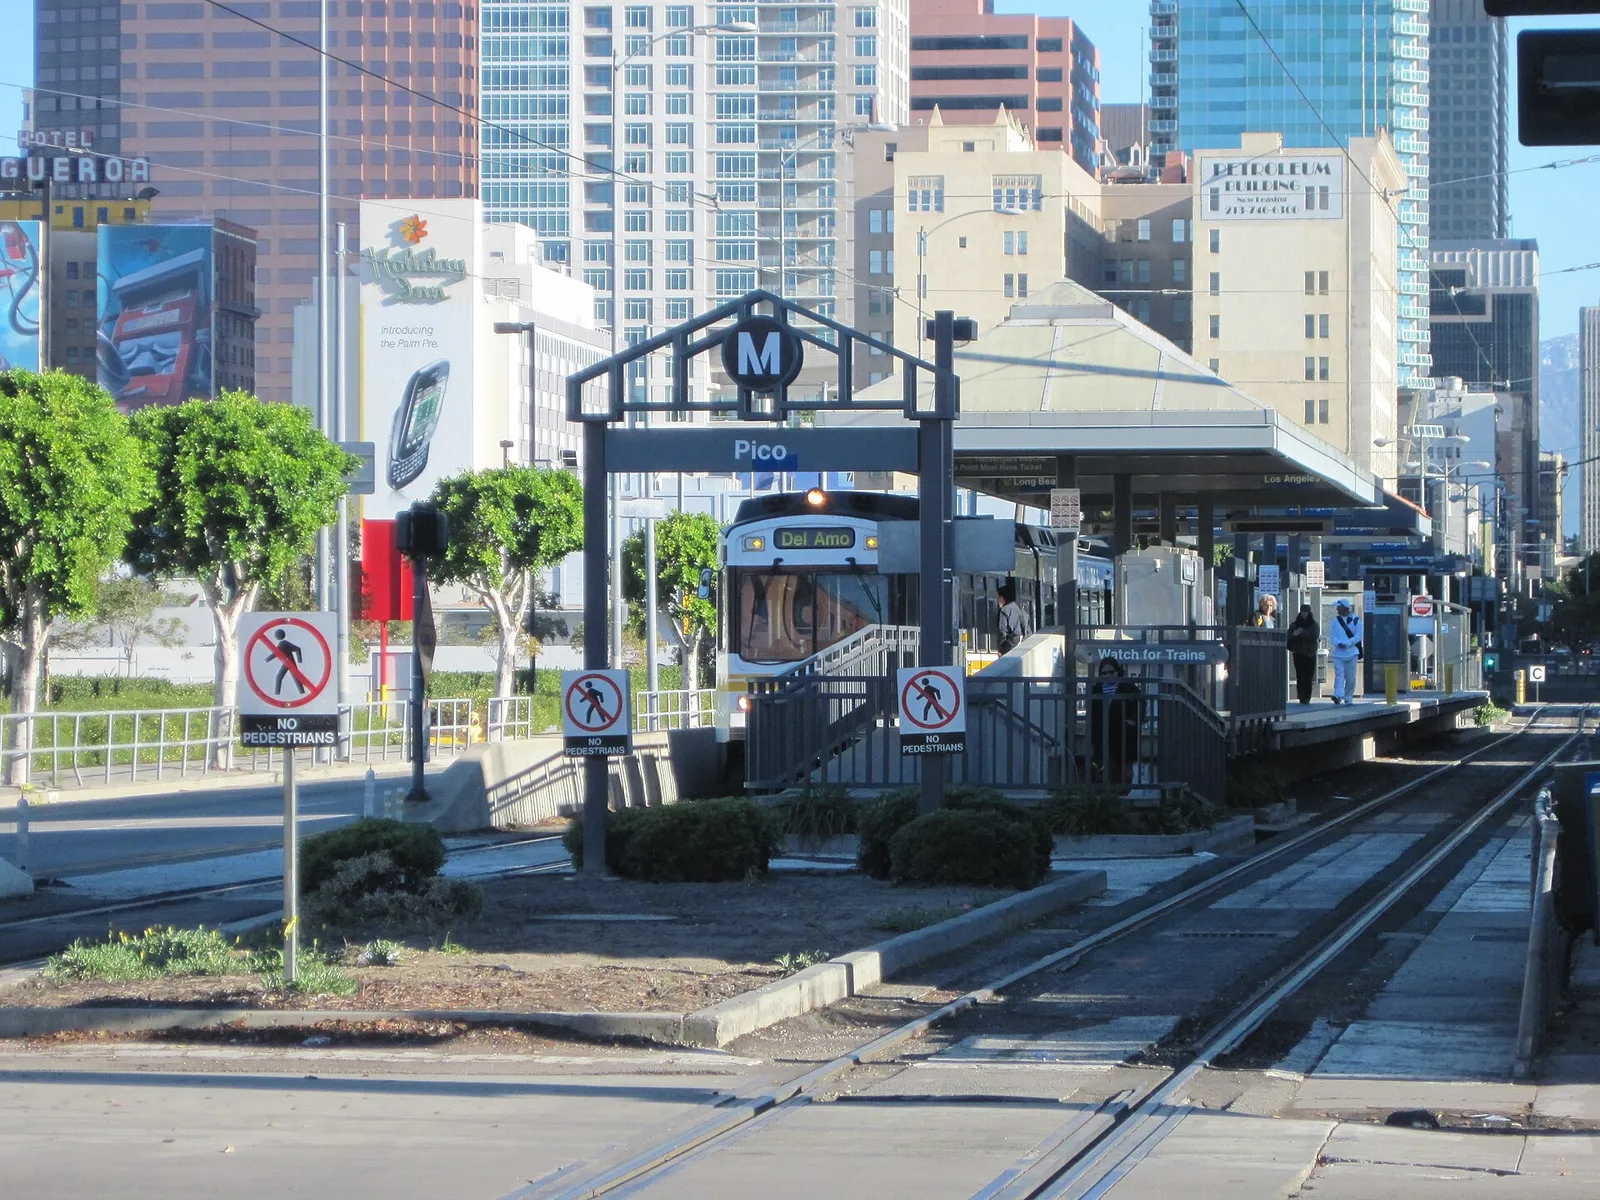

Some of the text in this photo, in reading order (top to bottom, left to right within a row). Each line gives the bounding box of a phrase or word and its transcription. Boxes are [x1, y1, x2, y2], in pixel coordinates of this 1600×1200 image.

[18, 131, 92, 147] HOTEL
[0, 156, 149, 181] GUEROA
[1213, 162, 1331, 176] PETROLEUM
[1225, 180, 1300, 192] BUILDING
[1256, 196, 1287, 204] Leasing
[368, 246, 467, 280] Holiday
[396, 278, 451, 300] Inn
[380, 325, 434, 337] Introducing
[380, 339, 396, 348] the
[397, 339, 420, 348] Palm
[738, 332, 780, 374] M
[734, 439, 787, 460] Pico
[960, 463, 979, 471] Point
[980, 463, 998, 471] Must
[1013, 477, 1036, 487] Long
[1264, 474, 1321, 484] Los Angeles
[781, 532, 850, 546] Del Amo
[1098, 649, 1206, 660] Watch for Trains
[1532, 667, 1543, 680] C
[277, 718, 297, 730] NO
[243, 732, 334, 744] PEDESTRIANS
[588, 737, 602, 746] NO
[925, 735, 940, 743] NO
[565, 746, 626, 755] PEDESTRIANS
[902, 743, 964, 753] PEDESTRIANS
